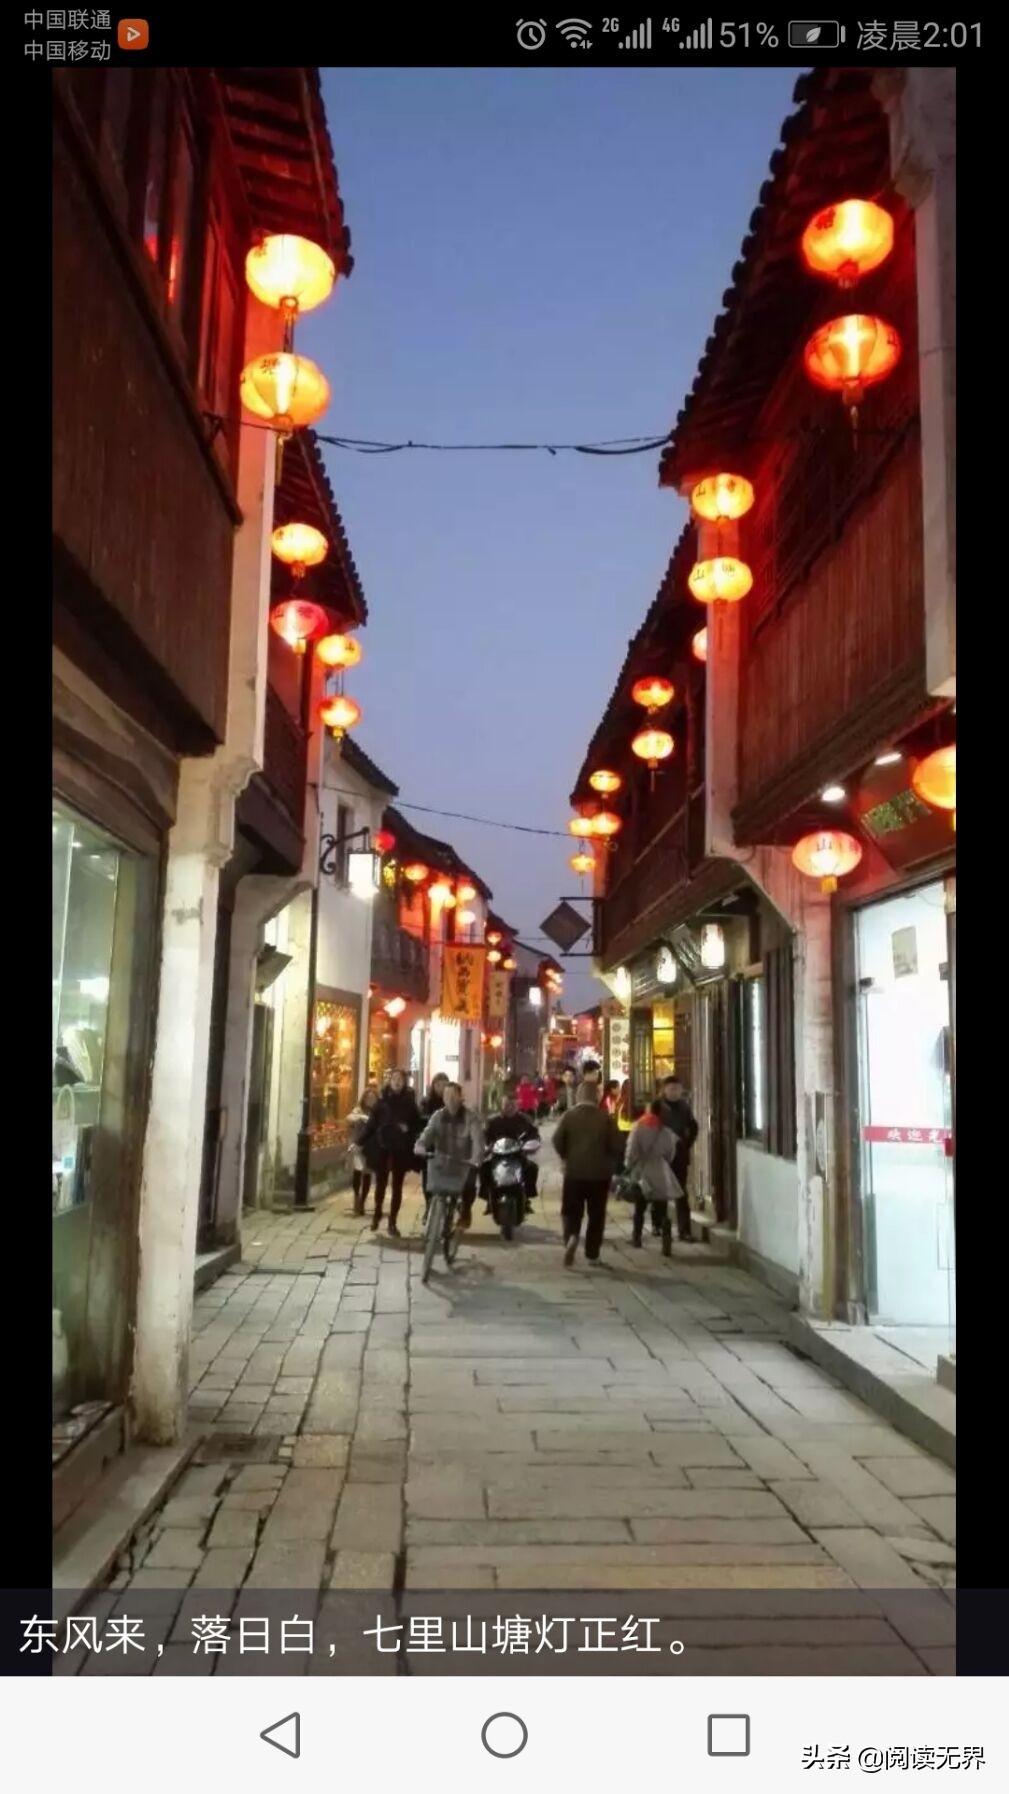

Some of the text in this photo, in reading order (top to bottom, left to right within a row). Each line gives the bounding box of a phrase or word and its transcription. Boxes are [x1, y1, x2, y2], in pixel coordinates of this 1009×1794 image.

[25, 9, 111, 30] 中国联通
[602, 18, 619, 32] 2G
[662, 18, 679, 32] 4G
[720, 22, 778, 47] 51%
[857, 20, 980, 50] 凌晨2:01
[25, 40, 110, 61] 中国移动
